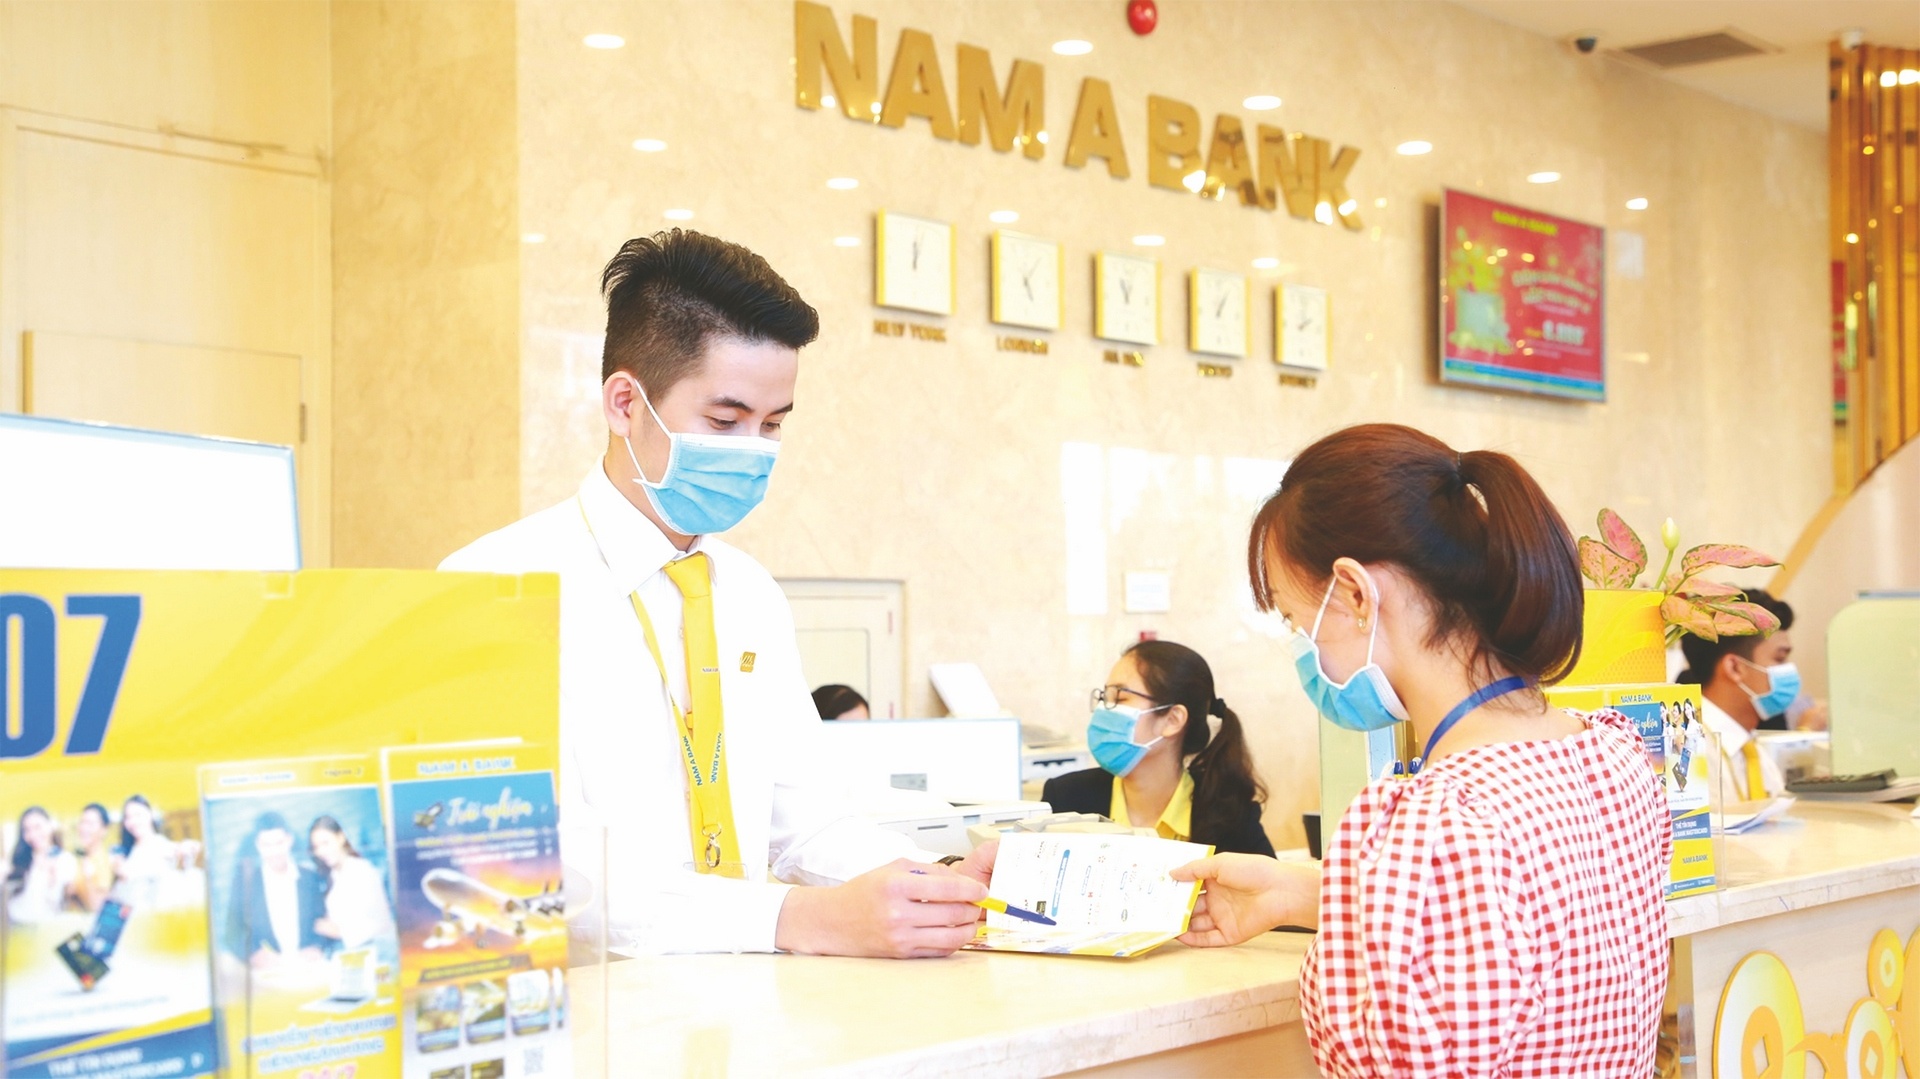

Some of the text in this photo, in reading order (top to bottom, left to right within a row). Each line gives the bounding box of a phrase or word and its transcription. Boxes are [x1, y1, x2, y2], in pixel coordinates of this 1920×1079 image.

[794, 0, 1364, 231] NAM A BANK
[0, 592, 142, 761] 07
[691, 765, 703, 786] NAM
[710, 760, 719, 784] BANK
